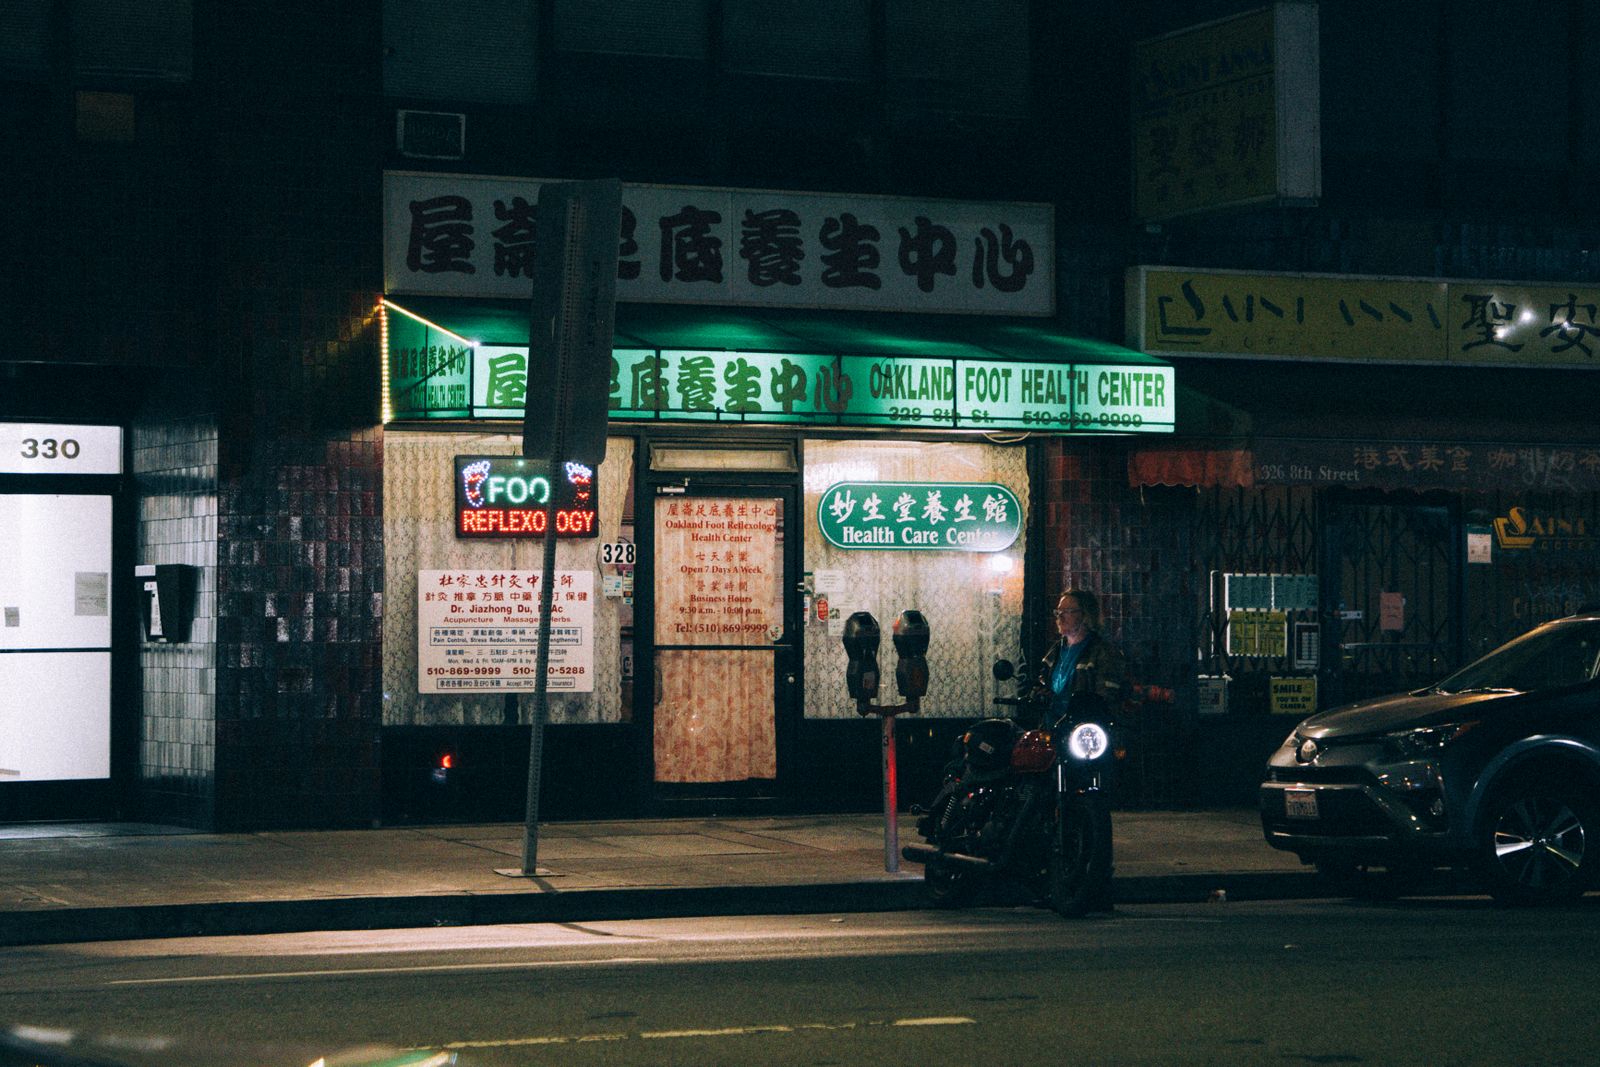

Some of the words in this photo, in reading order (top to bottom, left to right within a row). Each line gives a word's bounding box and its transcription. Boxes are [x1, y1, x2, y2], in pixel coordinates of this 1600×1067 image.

[486, 352, 853, 414] 屋底養生中心
[869, 362, 954, 401] OAKLAND
[965, 366, 1012, 404] FOOT
[1021, 368, 1089, 406] HEALTH
[1097, 371, 1166, 407] CENTER
[888, 406, 922, 421] 328
[932, 407, 960, 423] 8th
[971, 408, 995, 424] St.
[20, 437, 81, 460] 330
[1261, 464, 1285, 480] 326
[1290, 464, 1312, 480] 8th
[1318, 464, 1360, 481] Street
[487, 476, 551, 504] FOO
[828, 489, 1009, 525] 妙生堂養生館
[462, 509, 594, 533] REFLEXOOGY
[665, 520, 703, 530] Oakland
[705, 520, 725, 530] Foot
[727, 520, 776, 532] Reflexology
[691, 532, 721, 543] Health
[722, 533, 753, 543] Center
[842, 525, 895, 544] Health
[901, 526, 939, 545] Care
[945, 527, 999, 545] Center
[603, 543, 635, 563] 328
[680, 565, 703, 575] Open
[705, 565, 710, 574] 7
[711, 565, 731, 575] Days
[733, 565, 739, 574] A
[740, 565, 762, 574] Week
[438, 573, 574, 589] 杜家忠針灸中師
[690, 594, 726, 603] Business
[728, 594, 753, 603] Hours
[450, 604, 465, 613] Dr.
[469, 604, 512, 615] Jiazhong
[517, 604, 533, 614] Du,
[679, 606, 696, 615] 9:30
[443, 616, 494, 624] Acupuncture
[503, 616, 539, 624] Massage
[674, 623, 692, 633] Tel:
[427, 666, 502, 676] 510-869-9999
[512, 666, 585, 675] 510-0-5288
[1273, 684, 1302, 694] SMILE
